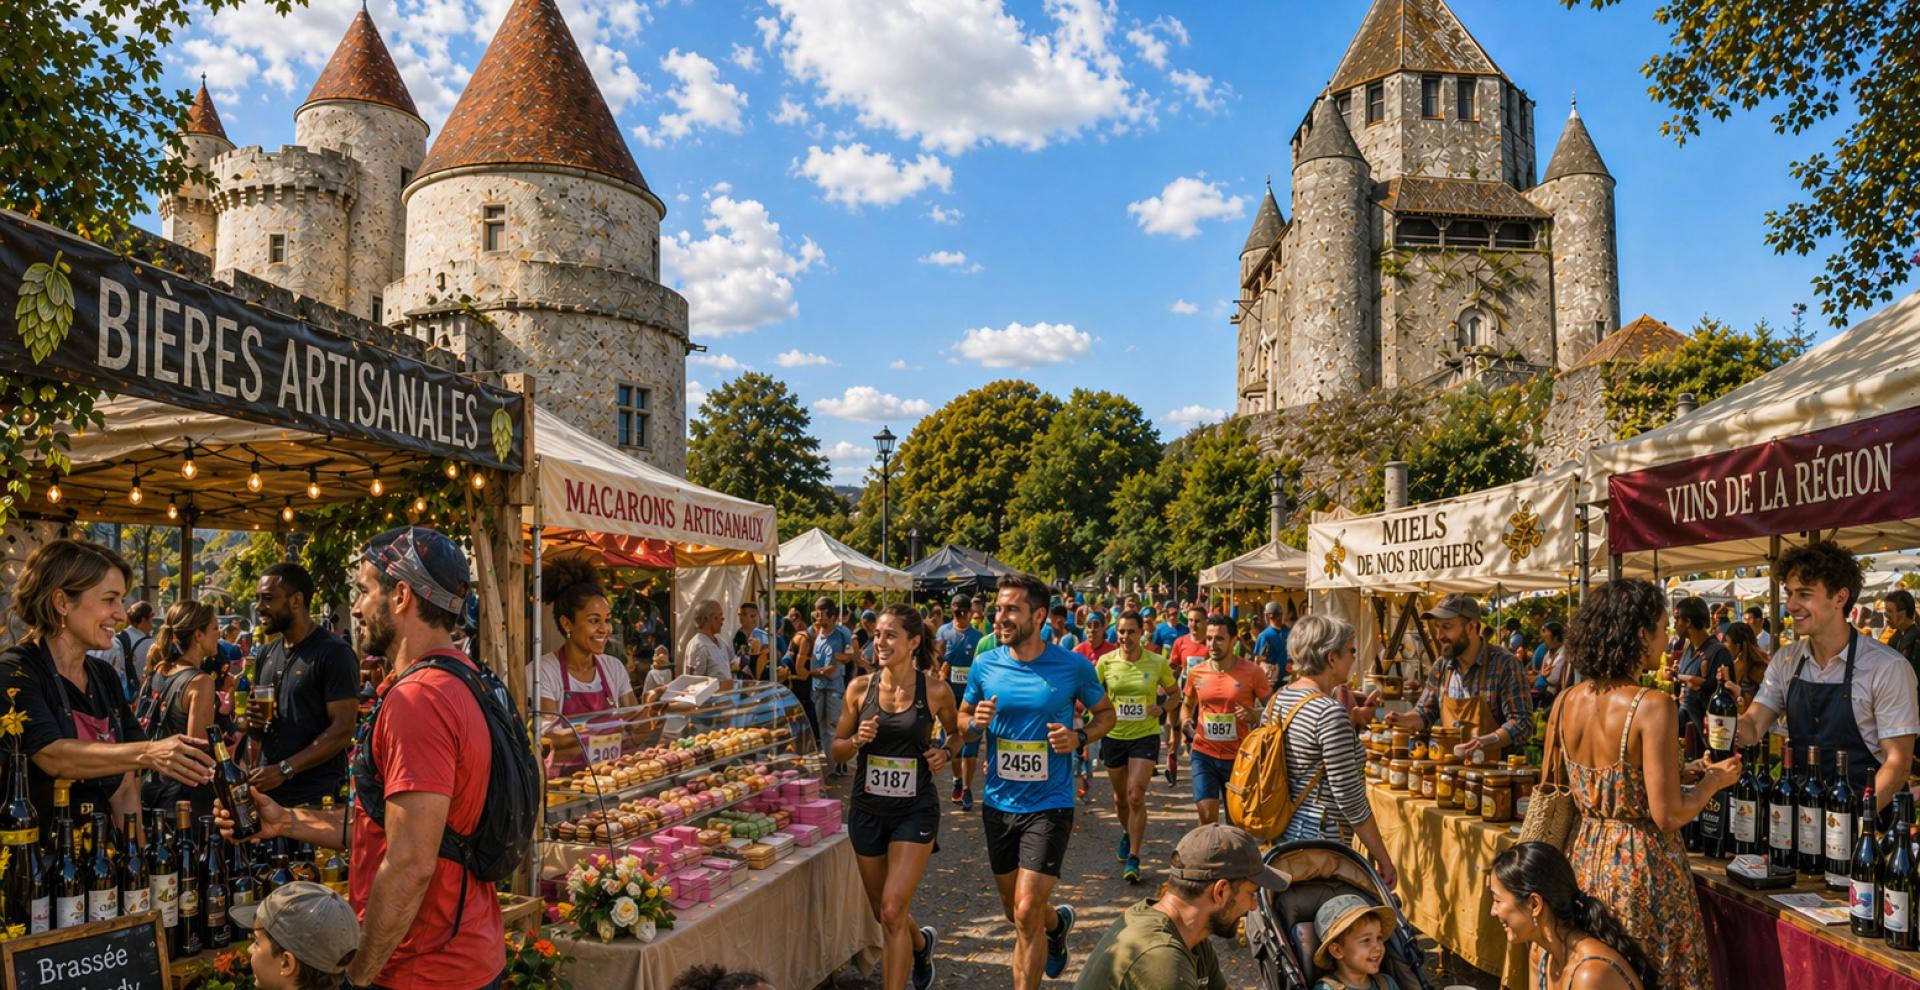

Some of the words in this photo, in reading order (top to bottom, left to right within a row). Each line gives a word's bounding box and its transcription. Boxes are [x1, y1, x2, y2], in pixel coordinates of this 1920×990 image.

[98, 275, 264, 402] BIÈRES
[277, 338, 478, 450] ARTISANALES
[1666, 480, 1718, 525] VINS
[1725, 473, 1753, 517] DE
[1758, 467, 1790, 512] LA
[1795, 442, 1894, 506] RÉGION
[564, 478, 676, 529] MACARONS
[683, 503, 764, 543] ARTISANAUX
[1382, 511, 1447, 546] MIELS
[1357, 554, 1373, 576] DE
[1376, 550, 1404, 575] NOS
[1408, 540, 1484, 572] RUCHERS
[871, 768, 911, 789] 3187
[1001, 753, 1042, 773] 2456
[37, 944, 128, 985] Brassée
